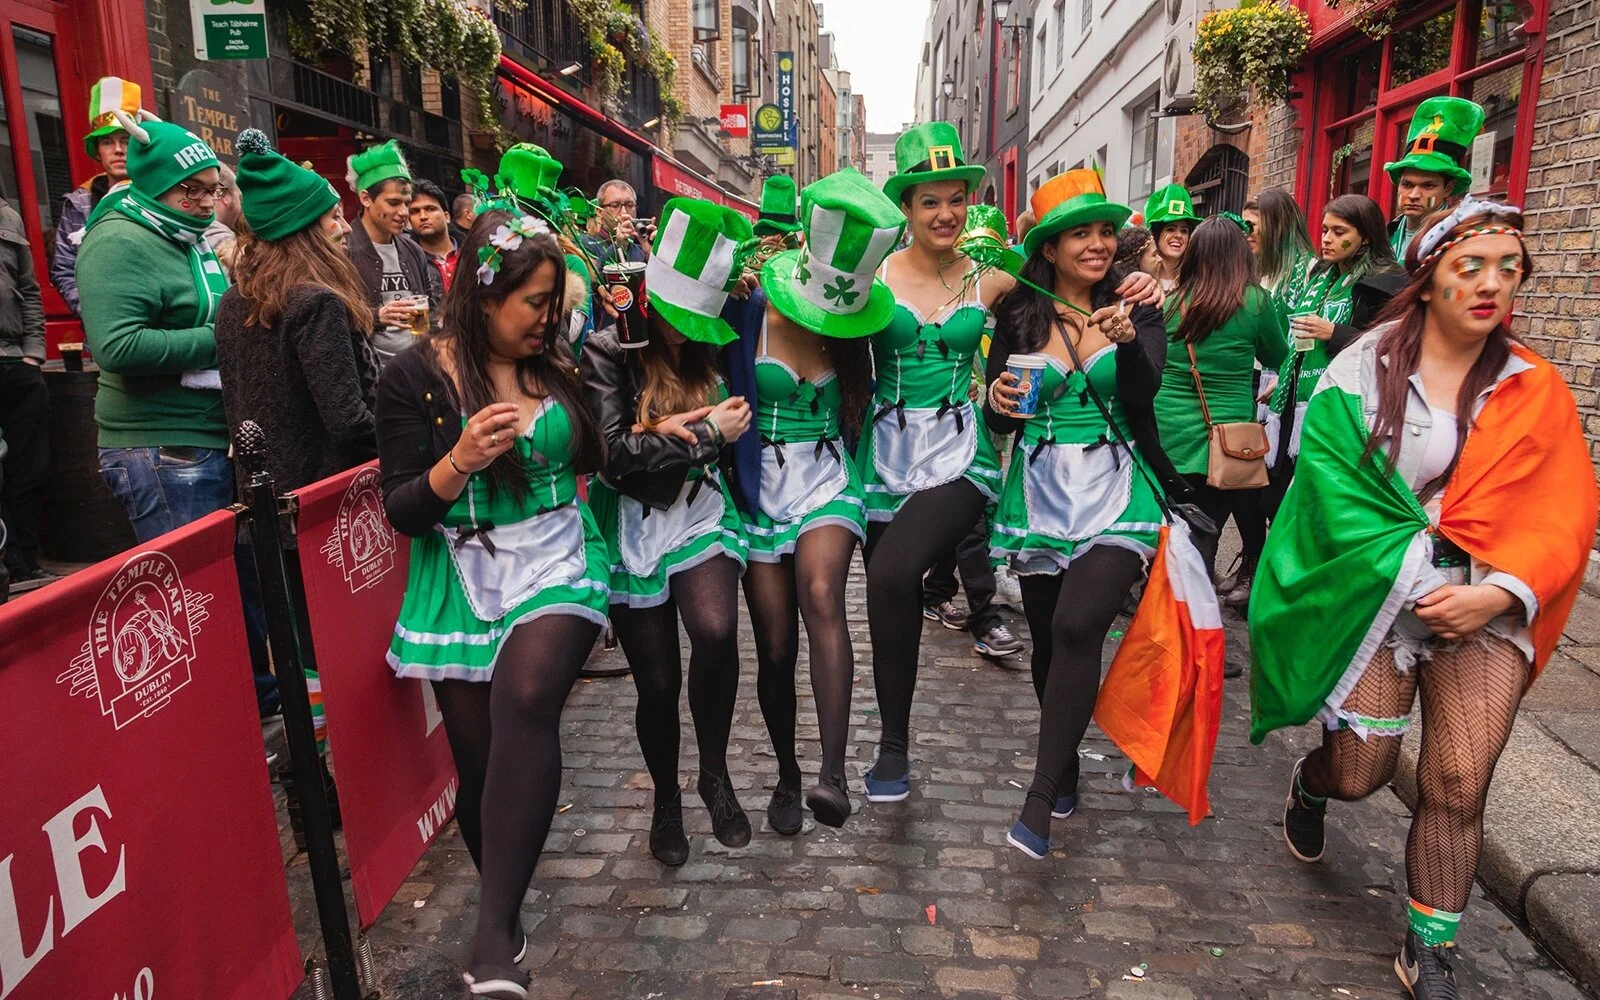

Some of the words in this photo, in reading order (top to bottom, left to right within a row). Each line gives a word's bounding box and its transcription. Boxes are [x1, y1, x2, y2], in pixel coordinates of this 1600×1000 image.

[210, 20, 229, 28] Teach
[202, 87, 220, 102] THE
[781, 75, 791, 141] HOSTEL
[184, 95, 239, 132] TEMPLE
[340, 506, 349, 541] THE
[361, 558, 384, 576] DUBLIN
[95, 610, 110, 658] THE
[107, 559, 166, 603] TEMPLE
[162, 573, 183, 617] BAR
[134, 671, 172, 701] DUBLIN
